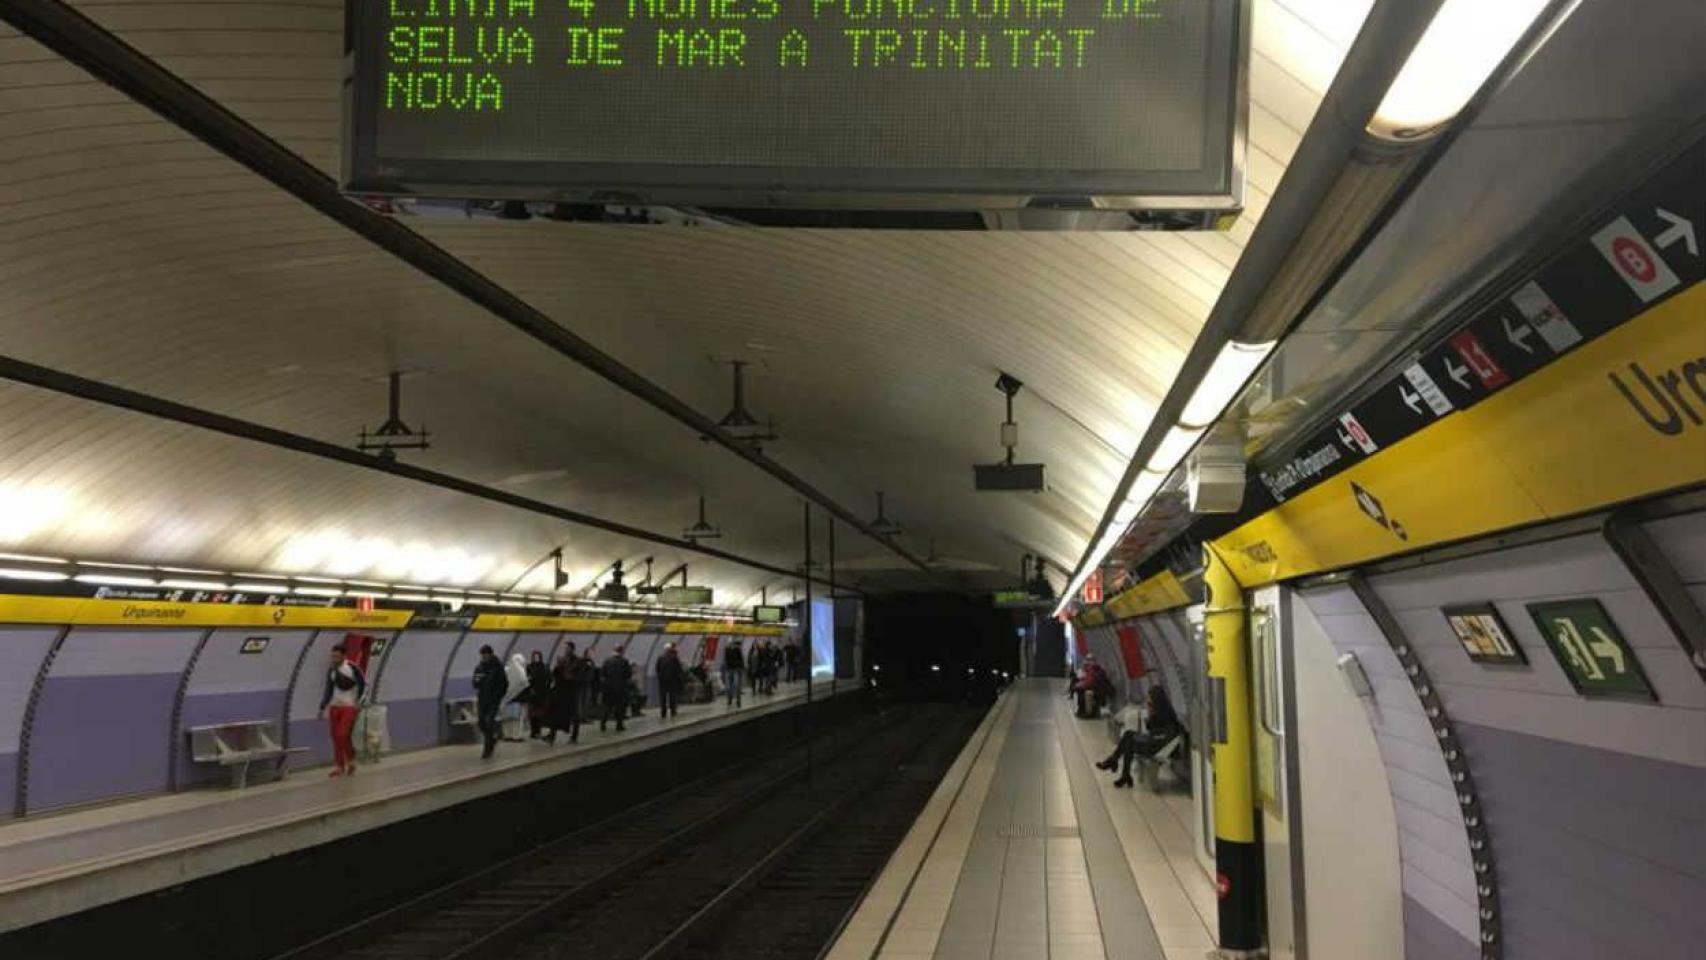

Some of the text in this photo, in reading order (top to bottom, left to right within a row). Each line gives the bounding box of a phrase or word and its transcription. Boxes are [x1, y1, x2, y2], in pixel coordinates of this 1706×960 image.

[389, 26, 536, 64] SELVA
[566, 27, 625, 65] DE
[657, 28, 747, 66] MAR
[779, 29, 808, 67] A
[386, 72, 503, 109] NOVA
